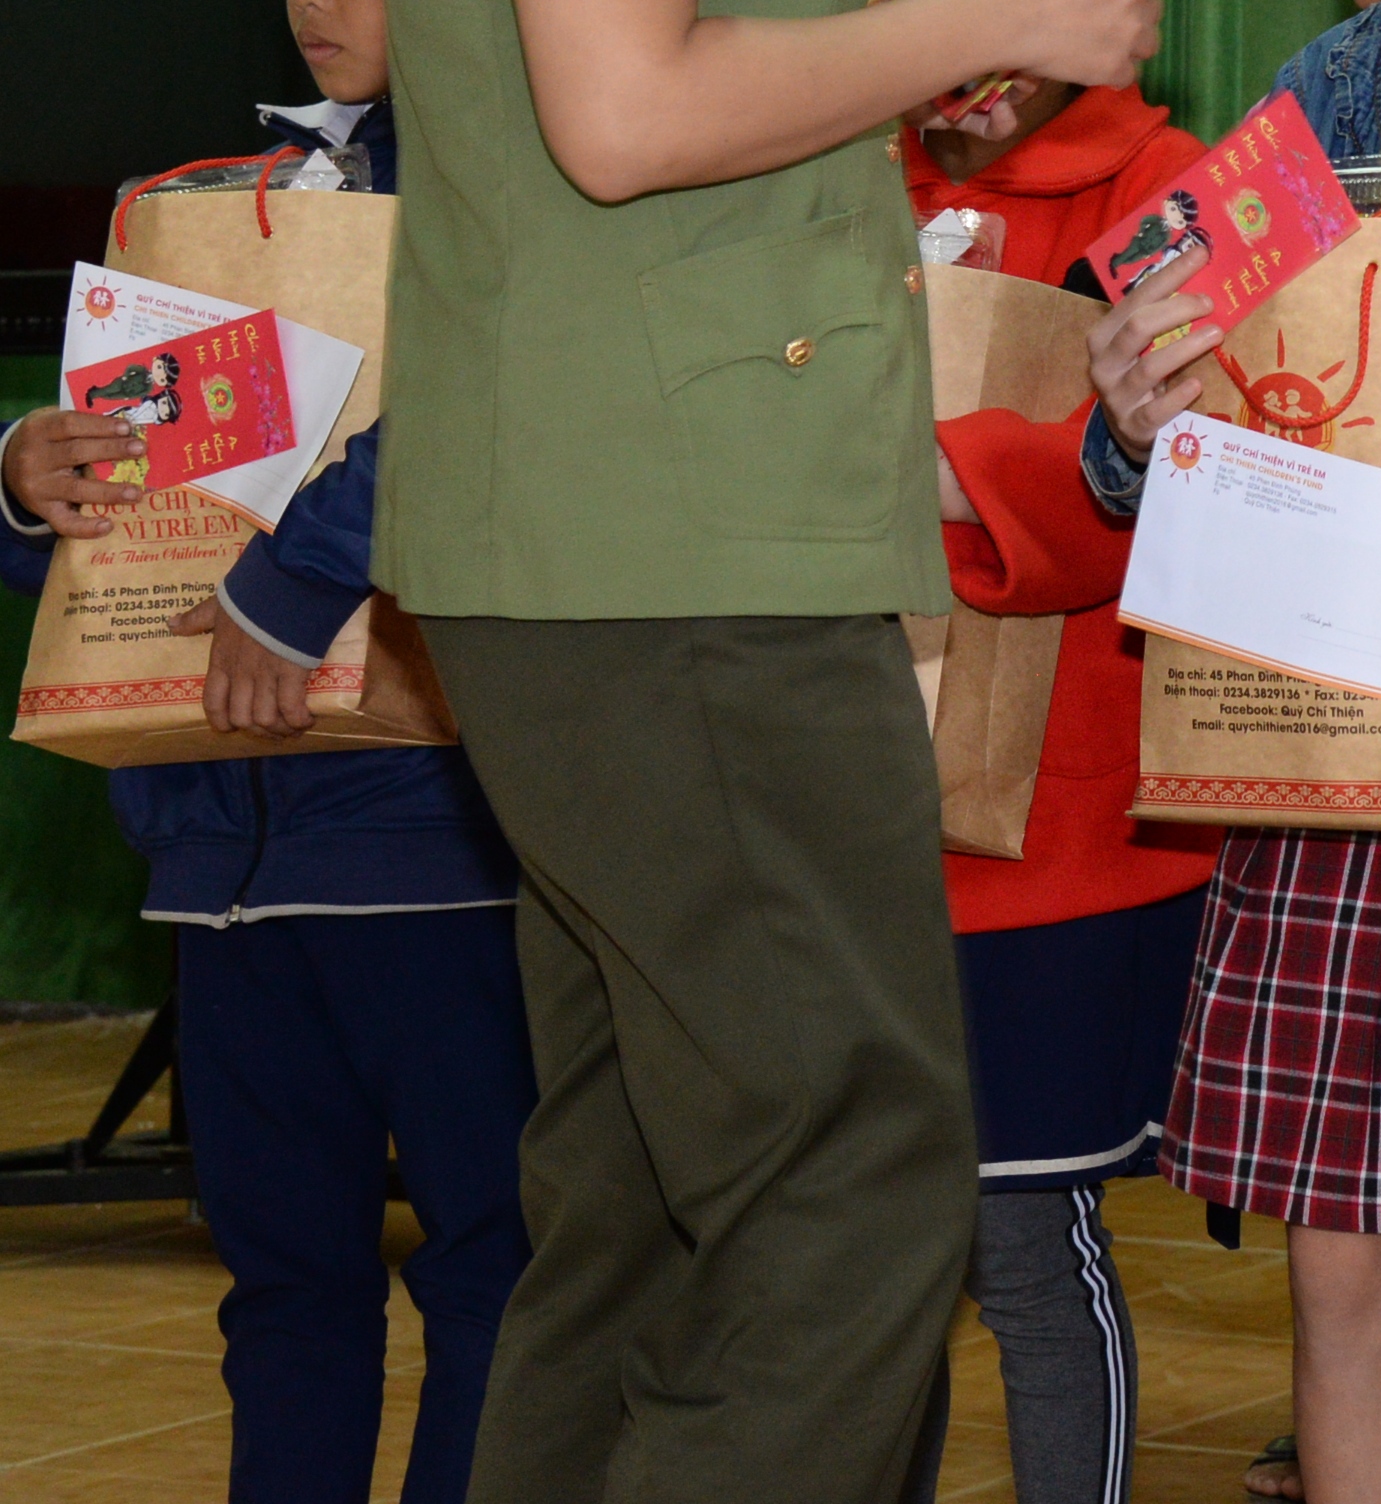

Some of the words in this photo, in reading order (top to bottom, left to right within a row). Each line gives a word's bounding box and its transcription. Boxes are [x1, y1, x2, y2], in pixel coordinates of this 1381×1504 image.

[1242, 447, 1259, 459] CHÍ
[1260, 452, 1284, 467] THIỆN
[1286, 459, 1295, 470] VÌ
[1313, 469, 1327, 479] EM
[1220, 454, 1234, 464] CHI
[1235, 458, 1256, 470] THIEN
[1303, 479, 1323, 490] FUND
[123, 515, 146, 540] VÌ
[151, 510, 198, 539] TRẺ
[204, 513, 240, 535] EM
[120, 549, 159, 563] Thien
[162, 544, 228, 561] Children's
[102, 588, 117, 597] 45
[120, 586, 149, 596] Phan
[115, 598, 195, 612] 0234.3829136
[81, 632, 116, 644] Email:
[1168, 668, 1184, 682] Địa
[1187, 667, 1206, 680] chỉ:
[1209, 670, 1223, 681] 45
[1226, 671, 1255, 682] Phan
[1257, 670, 1282, 683] Đình
[1164, 684, 1186, 699] Điện
[1189, 685, 1220, 700] thoại:
[1223, 688, 1300, 700] 0234.3829136
[1314, 690, 1339, 701] Fax:
[1219, 703, 1278, 716] Facebook:
[1281, 704, 1303, 718] Quỹ
[1306, 705, 1327, 717] Chí
[1330, 705, 1364, 721] Thiện
[1192, 718, 1225, 731] Email:
